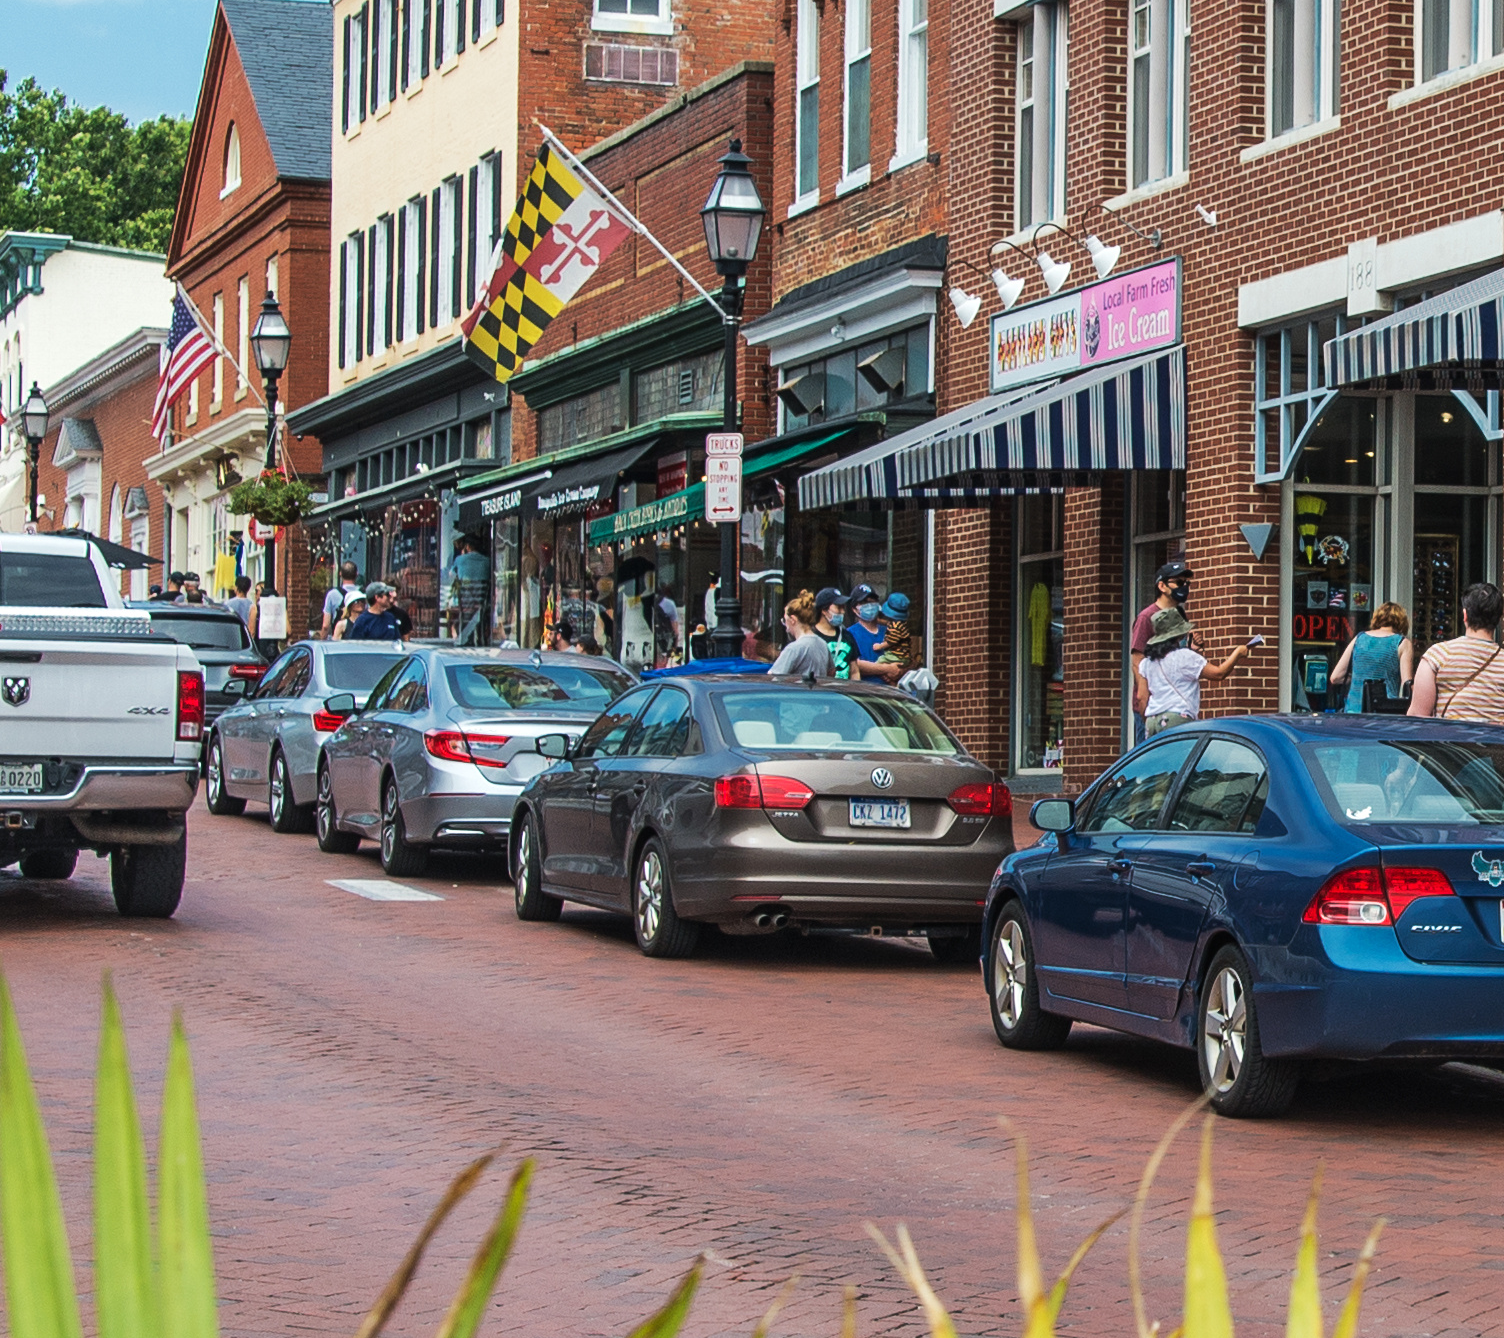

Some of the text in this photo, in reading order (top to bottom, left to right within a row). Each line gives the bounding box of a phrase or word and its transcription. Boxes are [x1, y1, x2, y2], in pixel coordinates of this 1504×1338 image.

[1350, 259, 1373, 291] 188
[1103, 270, 1176, 311] Local Farm Fresh
[1107, 306, 1170, 351] Ice Cream
[711, 439, 739, 450] TRUCKS
[719, 461, 729, 471] NO
[709, 474, 738, 483] STOPPING
[480, 489, 522, 517] TREASURE ISLAND
[1293, 613, 1356, 641] OPEN
[9, 771, 41, 787] 0220
[853, 804, 873, 820] CKZ
[1411, 925, 1463, 933] CIVIC
